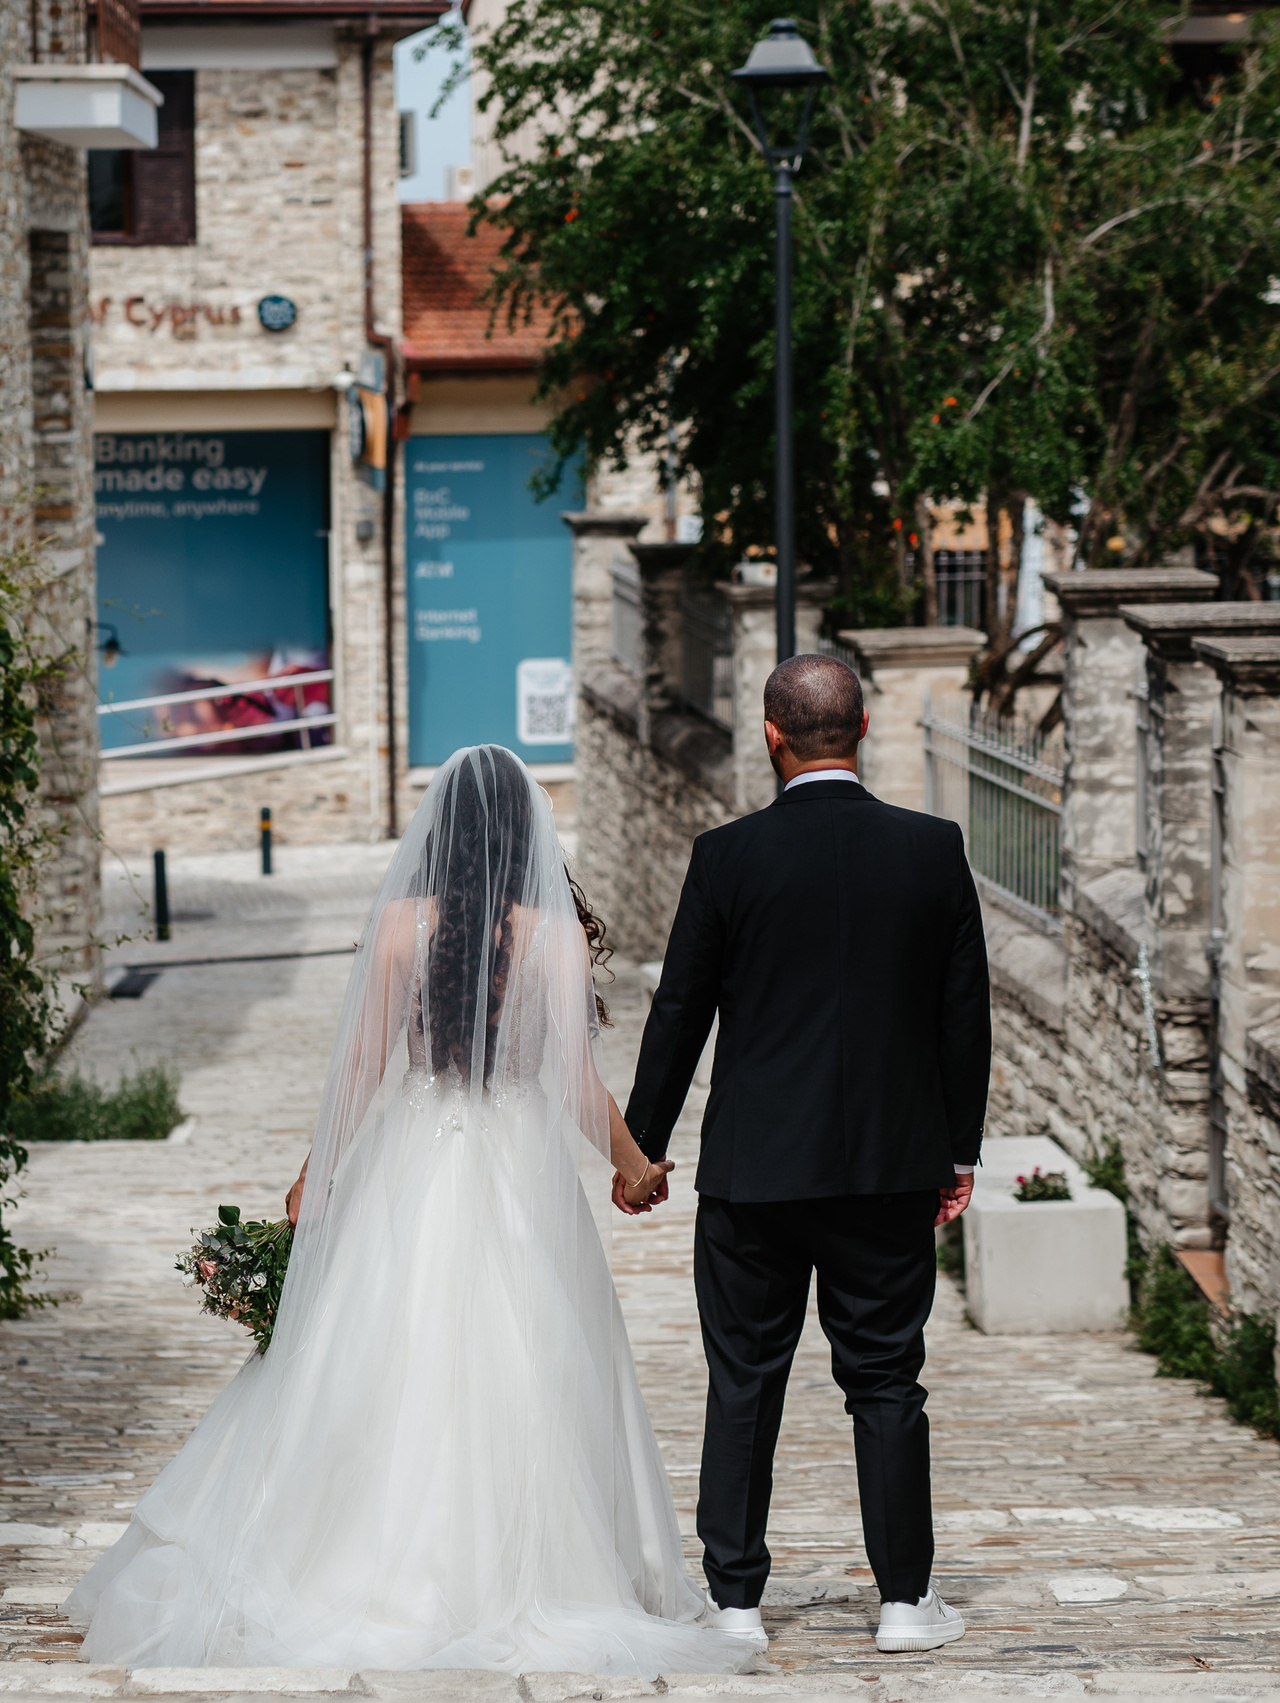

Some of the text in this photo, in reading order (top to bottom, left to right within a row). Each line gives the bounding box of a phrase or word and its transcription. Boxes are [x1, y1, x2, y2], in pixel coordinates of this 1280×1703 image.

[125, 297, 241, 334] Cyprus
[96, 433, 225, 466] Banking
[95, 463, 268, 496] made easy
[172, 498, 261, 520] anywhere
